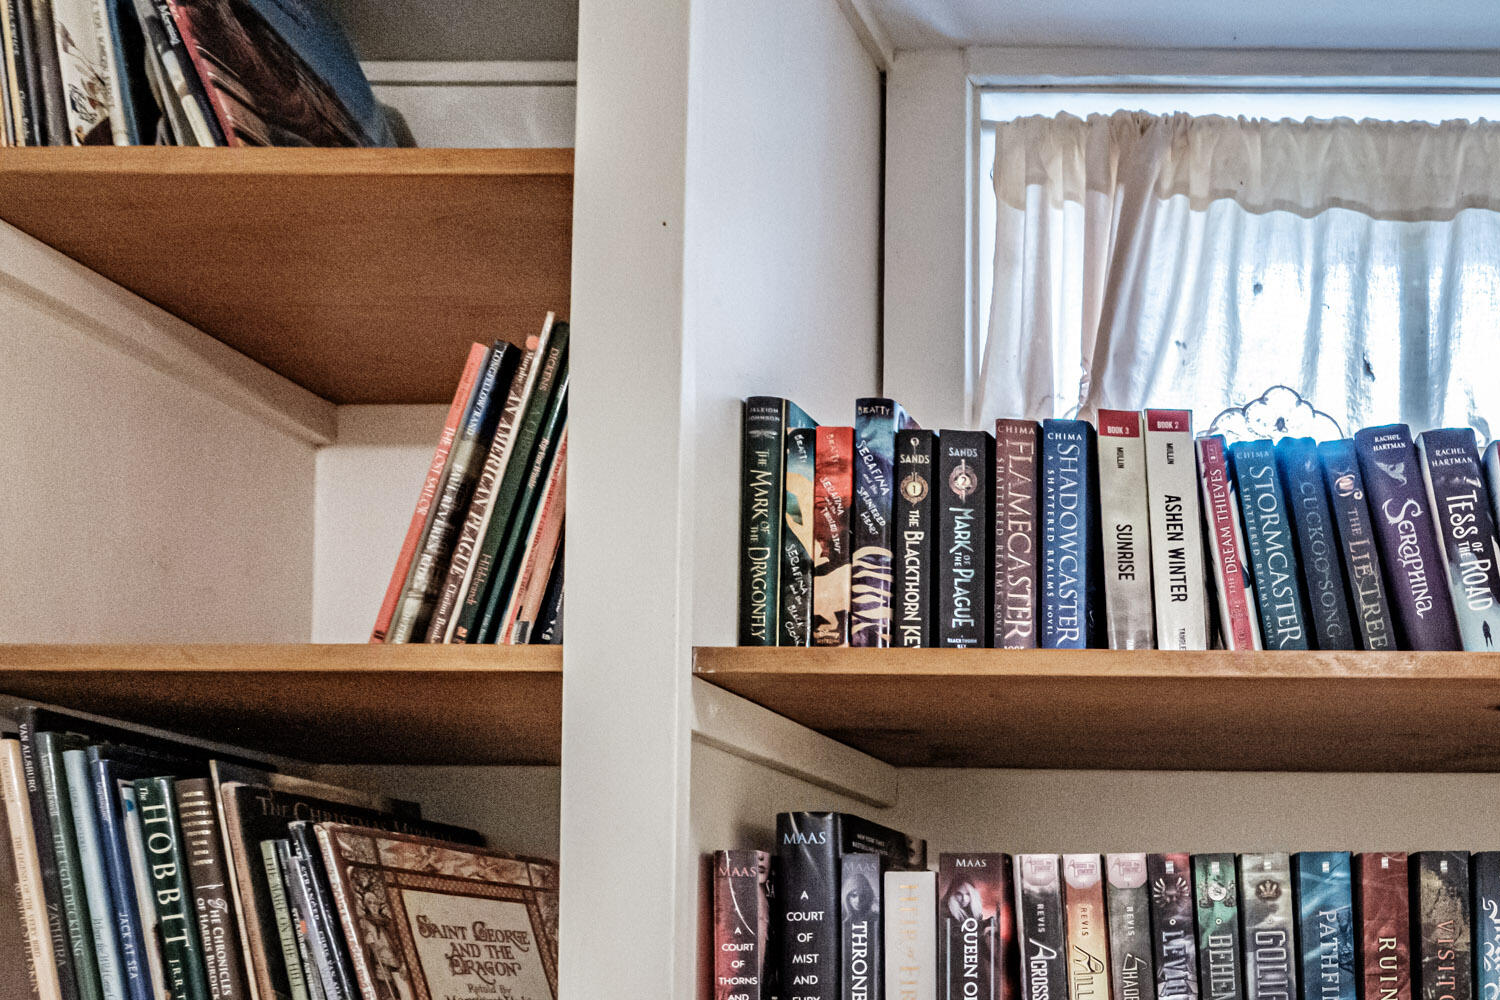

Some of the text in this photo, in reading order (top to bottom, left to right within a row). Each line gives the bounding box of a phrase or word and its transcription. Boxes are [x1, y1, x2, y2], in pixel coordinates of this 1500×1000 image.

[997, 425, 1035, 435] CHIMA
[755, 451, 769, 465] THE
[900, 454, 930, 464] SANDS
[450, 390, 521, 580] AN AMERICAN PLAGUE
[750, 469, 772, 519] MARK
[761, 521, 768, 533] OF
[910, 510, 920, 528] THE
[949, 506, 973, 554] MARK
[1004, 439, 1034, 640] FLAMECASTER
[963, 554, 971, 566] OF
[1058, 443, 1080, 646] SHADOWCASTER
[1115, 524, 1135, 581] SUNRISE
[1164, 495, 1188, 603] ASHEN WINTER
[1250, 466, 1301, 648] STORMCASTER
[1446, 489, 1493, 612] TESS OF THE ROAD
[748, 547, 770, 640] DRAGONFLY
[905, 531, 924, 622] BLACKTHORN
[952, 568, 975, 629] PLAGUE
[1348, 507, 1388, 650] THE LIE TREE
[139, 787, 191, 948] The HOBBIT
[956, 859, 987, 868] MAAS
[197, 897, 206, 910] OF
[786, 911, 824, 921] COURT
[801, 891, 809, 899] A
[207, 898, 233, 995] THE CHRONICLES
[444, 943, 515, 960] AND THE
[792, 954, 819, 964] MIST
[798, 932, 813, 942] OF
[960, 918, 978, 978] QUEEN
[794, 975, 818, 985] AND
